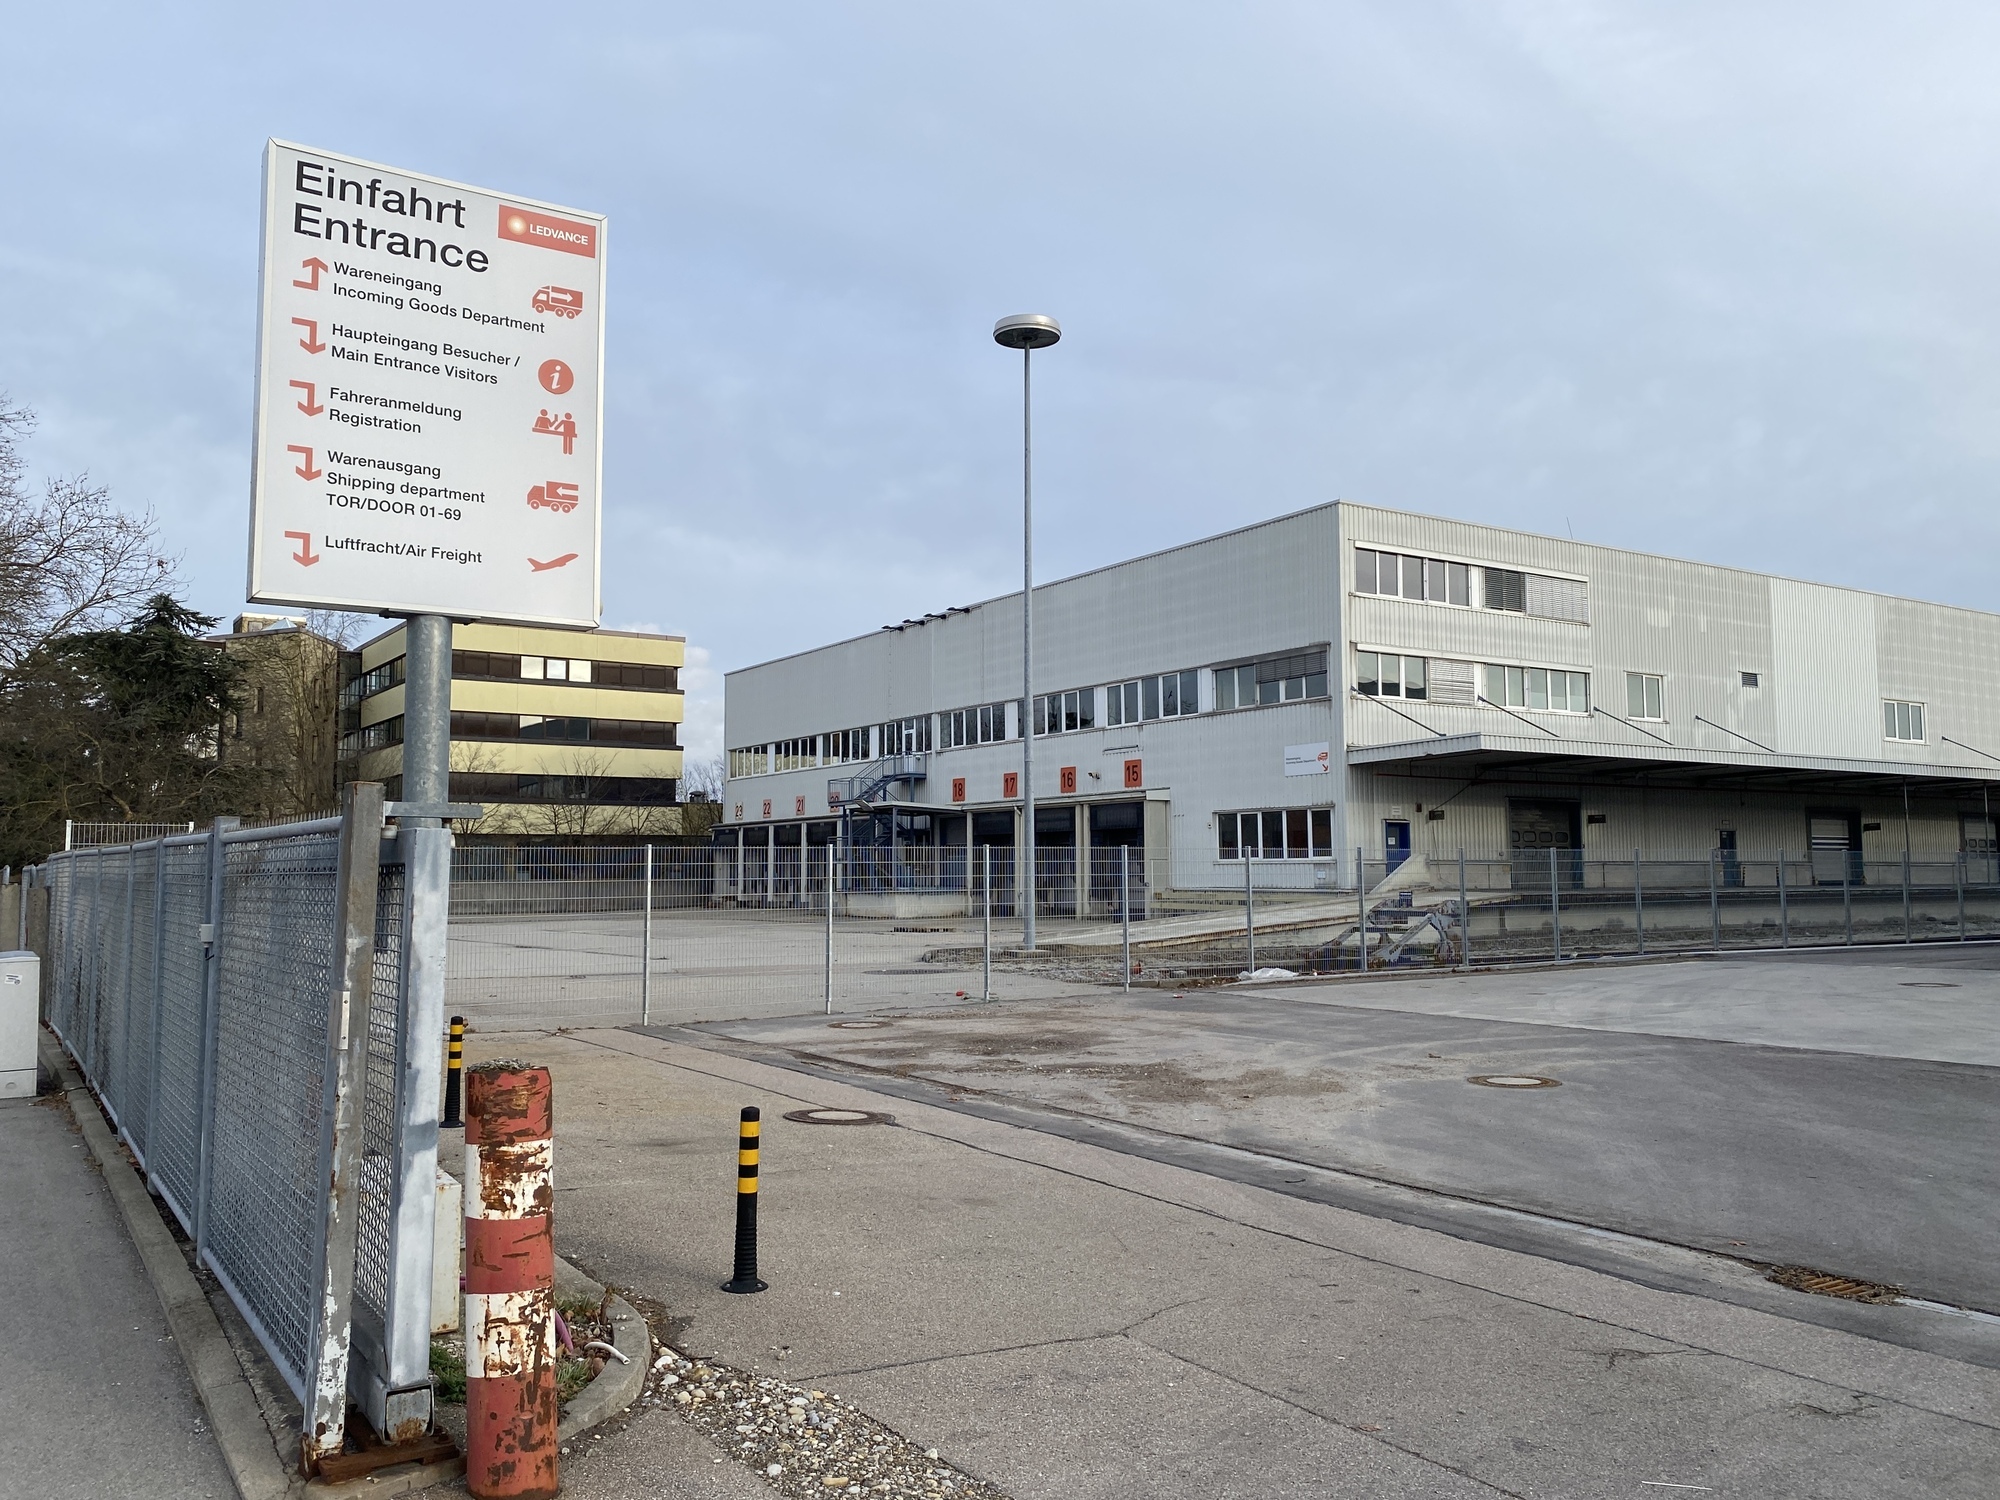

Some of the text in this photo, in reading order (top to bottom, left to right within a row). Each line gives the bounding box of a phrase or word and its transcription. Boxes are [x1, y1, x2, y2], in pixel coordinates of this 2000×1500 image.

[296, 160, 466, 229] Einfahrt
[293, 202, 489, 274] Entrance
[530, 223, 589, 246] LEDVANCE
[333, 261, 442, 297] Wareneingang
[333, 282, 545, 334] Incoming Goods Department
[332, 323, 438, 356] Haupteingang
[443, 343, 511, 366] Besucher
[331, 345, 498, 385] Main Entrance Visitors
[330, 386, 462, 422] Fahreranmeldung
[329, 408, 421, 434] Registration
[327, 450, 441, 480] Warenausgang
[326, 471, 485, 504] Shipping department
[325, 493, 462, 521] TOR/DOOR 01-69
[325, 535, 482, 568] Luftfracht/Air Freight
[1004, 777, 1015, 793] 17
[1061, 771, 1074, 788] 16
[1126, 764, 1139, 783] 15
[953, 782, 963, 797] 18
[735, 805, 743, 817] 23
[763, 802, 771, 815] 22
[796, 799, 804, 812] 21
